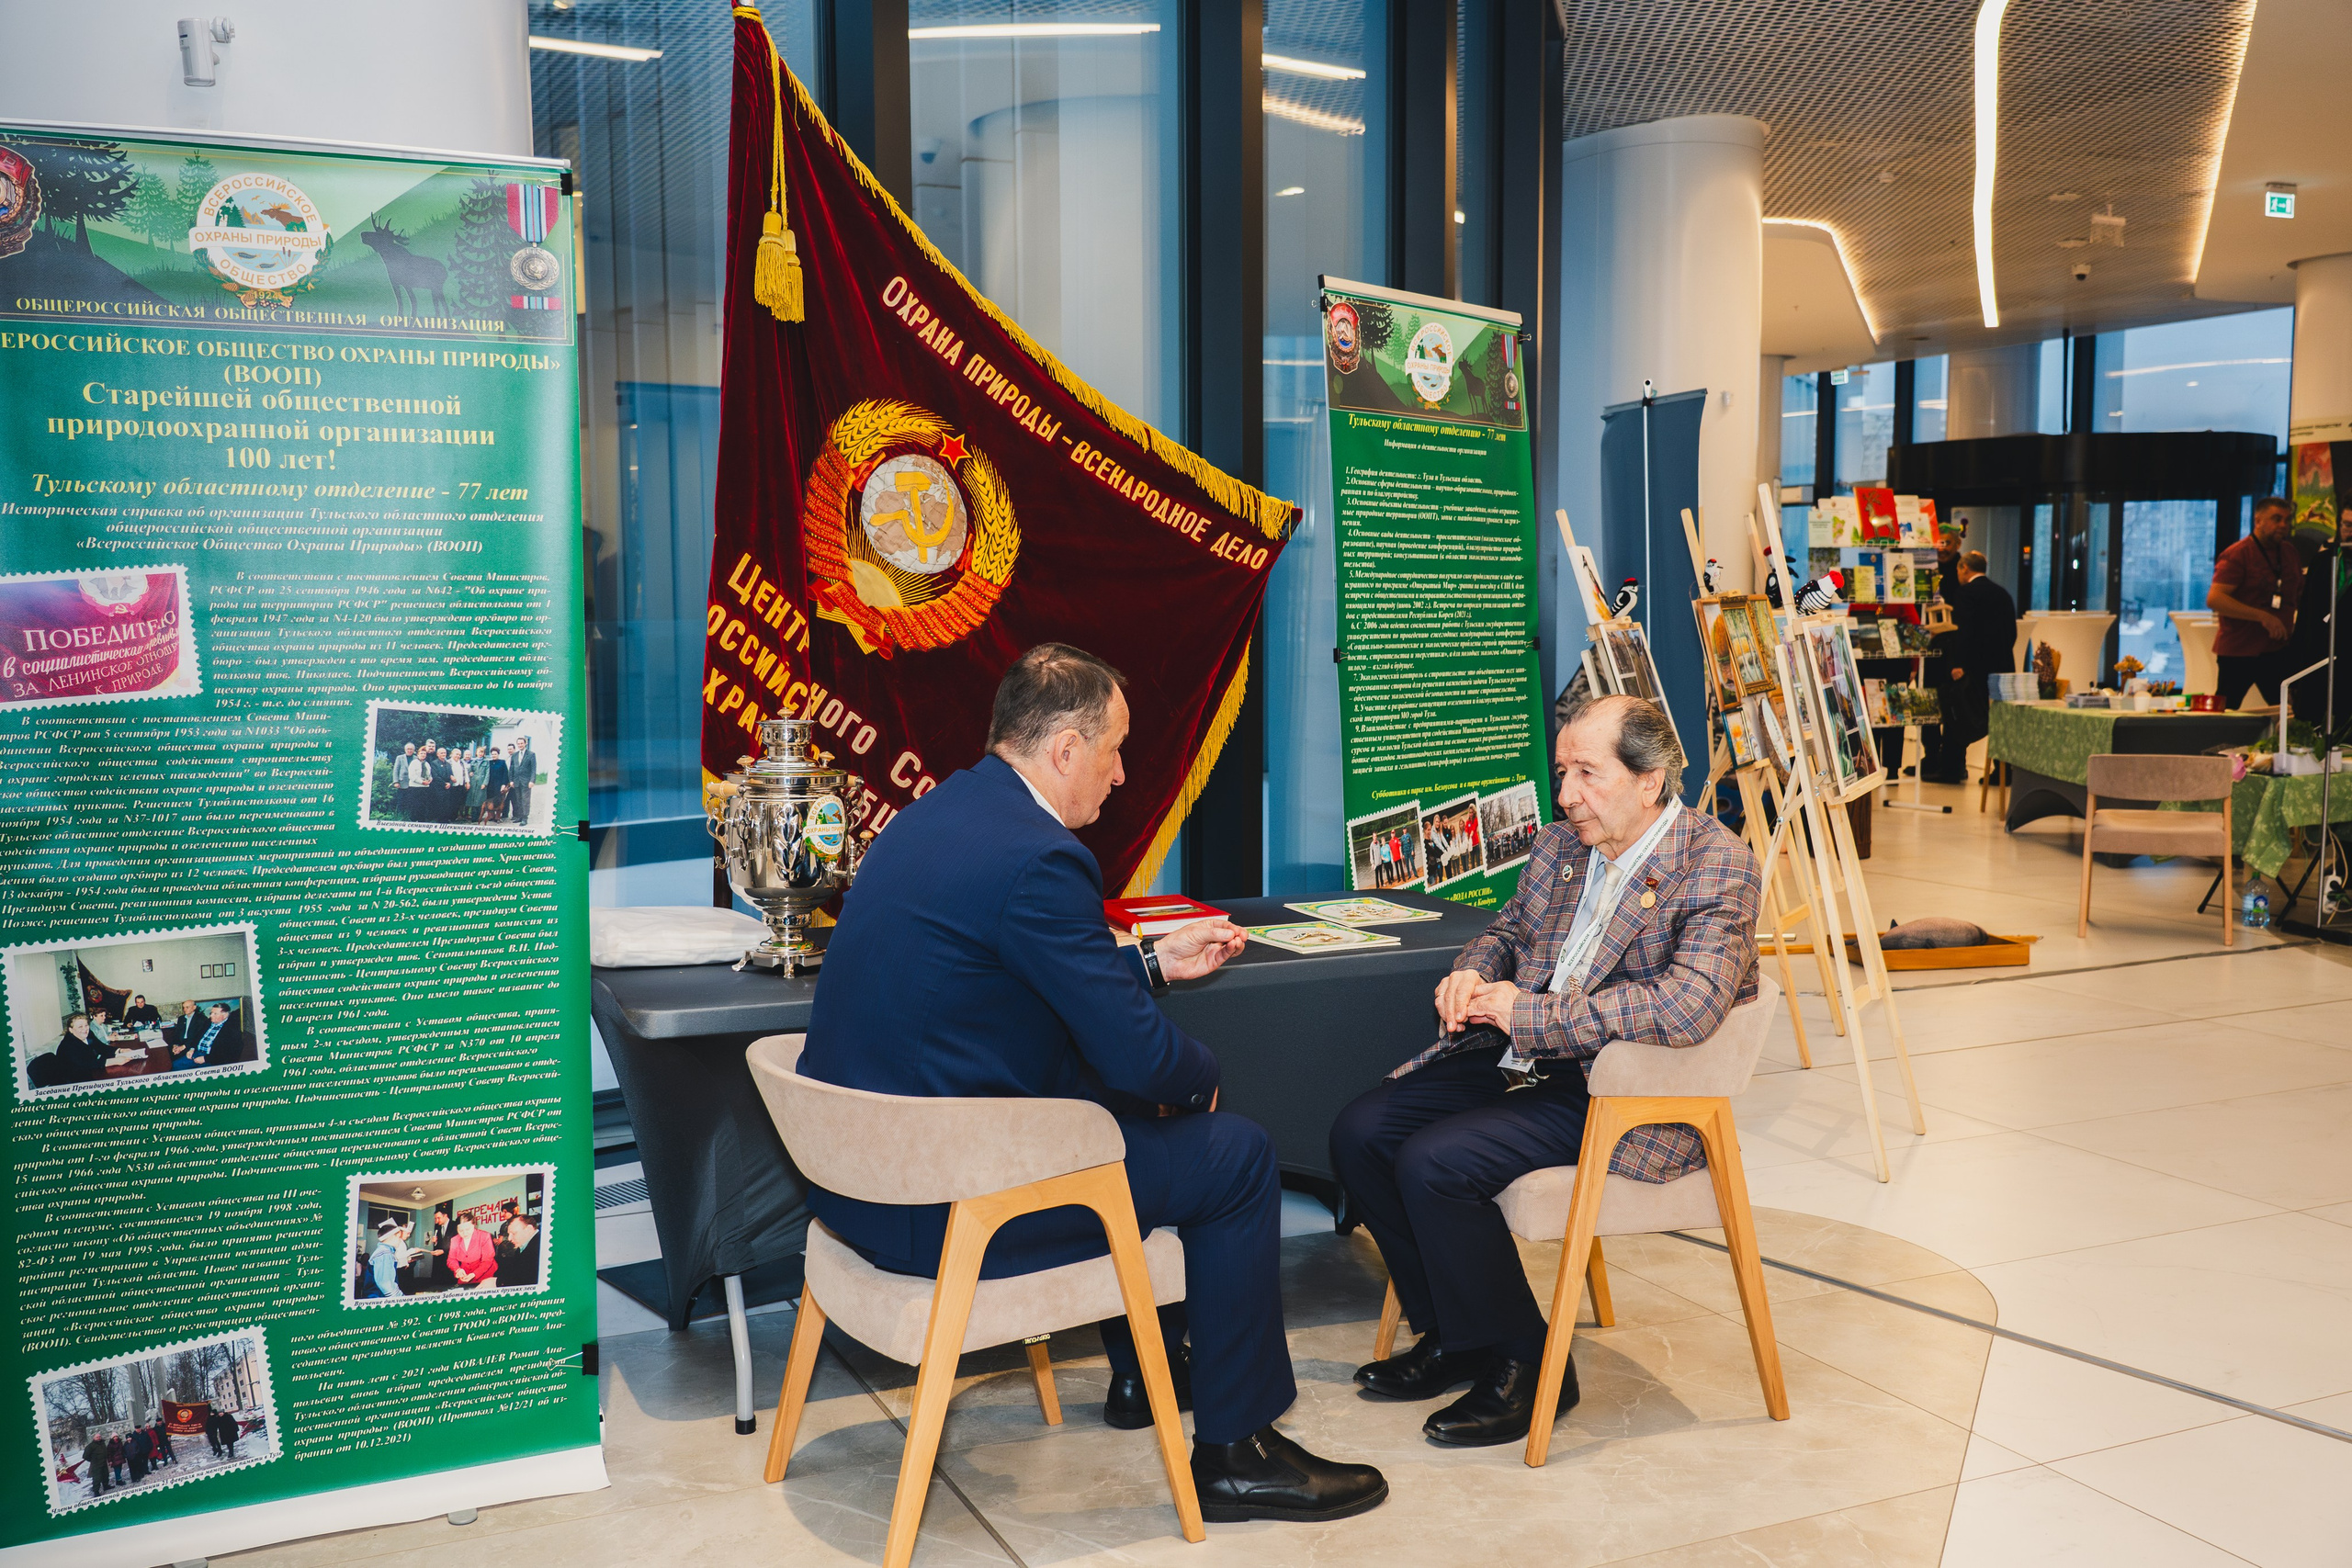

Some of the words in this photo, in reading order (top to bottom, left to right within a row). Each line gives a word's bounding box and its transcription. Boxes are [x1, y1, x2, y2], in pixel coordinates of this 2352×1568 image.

[204, 176, 317, 223] ВСЕРОССИЙСКОЕ
[195, 231, 253, 243] ОХРАНЫ
[256, 234, 322, 249] ПРИРОДЫ
[220, 258, 307, 286] ОБЩЕСТВО
[254, 289, 278, 300] 1924
[16, 298, 205, 317] ОБЩЕРОССИЙСКАЯ
[214, 308, 366, 325] ОБЩЕСТВЕННАЯ
[379, 315, 503, 332] ОРГАНИЗАЦИЯ
[0, 333, 190, 355] ЕРОССИЙСКОЕ
[196, 341, 334, 360] ОБЩЕСТВО
[340, 346, 435, 365] ОХРАНЫ
[442, 351, 560, 370] ПРИРОДЫ»
[223, 365, 322, 388] (ВООП)
[1417, 380, 1448, 400] ОБЩЕСТВО
[82, 381, 252, 411] Старейшей
[261, 389, 461, 414] общественной
[47, 418, 310, 442] природоохранной
[318, 425, 494, 446] организации
[882, 276, 966, 367] ОХРАНА
[963, 353, 1062, 443] ПРИРОДЫ
[1070, 440, 1212, 543] ВСЕНАРОДНОЕ
[1210, 531, 1269, 570] ДЕЛО
[1348, 412, 1392, 431] Тульскому
[1392, 418, 1439, 436] областному
[1440, 425, 1481, 437] отделению
[1487, 428, 1495, 439] 77
[1495, 431, 1507, 442] лет
[226, 446, 271, 468] 100
[278, 448, 335, 469] лет!
[31, 473, 156, 498] Тульскому
[163, 477, 308, 501] областному
[313, 481, 435, 499] отделение
[458, 481, 482, 499] 77
[484, 488, 528, 500] лет
[0, 502, 118, 518] Историческая
[121, 507, 183, 519] справка
[187, 509, 205, 517] об
[209, 509, 304, 520] организации
[311, 507, 379, 522] Тульского
[382, 512, 467, 520] областного
[469, 511, 544, 522] отделения
[75, 536, 198, 551] «Всероссийское
[202, 537, 283, 550] Общество
[287, 538, 345, 553] Охраны
[349, 539, 423, 554] Природы»
[426, 540, 483, 553] (ВООП)
[105, 524, 233, 536] общероссийской
[237, 525, 348, 536] общественной
[351, 526, 443, 538] организации
[235, 570, 244, 580] В
[442, 571, 482, 581] Совета
[23, 611, 175, 651] ПОБЕДИТЕЛЮ
[3, 657, 17, 679] в
[13, 682, 40, 698] ЗА
[49, 660, 133, 692] ЛЕНИНСКОЕ
[137, 641, 178, 666] ОТНОШЕ
[707, 604, 809, 717] ОССИЙС
[95, 685, 105, 695] К
[111, 662, 164, 692] ПРИРОДЕ
[1567, 933, 1590, 967] ВСЕРОССИЙСКОЕ
[34, 1088, 71, 1097] Заседание
[72, 1081, 115, 1092] Президиума
[116, 1077, 151, 1087] Тульского
[153, 1071, 194, 1082] областного
[194, 1067, 220, 1077] Совета
[221, 1065, 244, 1073] ВООП
[318, 1381, 334, 1391] На
[336, 1379, 365, 1388] пять
[368, 1374, 389, 1383] лет
[401, 1367, 424, 1378] 2021
[426, 1364, 449, 1374] года
[452, 1353, 505, 1370] КОВАЛЕВ
[508, 1349, 539, 1359] Роман
[542, 1346, 567, 1355] Ана-
[292, 1394, 344, 1407] тольевич
[349, 1389, 379, 1398] вновь
[386, 1382, 421, 1393] избран
[427, 1368, 503, 1387] председателем
[294, 1406, 345, 1421] Тульского
[346, 1396, 409, 1411] областного
[410, 1387, 466, 1401] отделения
[467, 1372, 549, 1392] общероссийской
[550, 1368, 566, 1378] об-
[293, 1416, 360, 1433] щественной
[364, 1405, 430, 1423] организации
[435, 1392, 514, 1409] «Всероссийское
[516, 1382, 567, 1396] общество
[293, 1434, 333, 1447] охраны
[337, 1426, 389, 1440] природы»
[392, 1416, 434, 1430] (ВООП)
[437, 1407, 493, 1423] (Протокол
[496, 1398, 533, 1413] №12/21
[552, 1395, 568, 1404] из-
[294, 1448, 334, 1461] брании
[334, 1444, 352, 1452] от
[355, 1432, 412, 1450] 10.12.2021)
